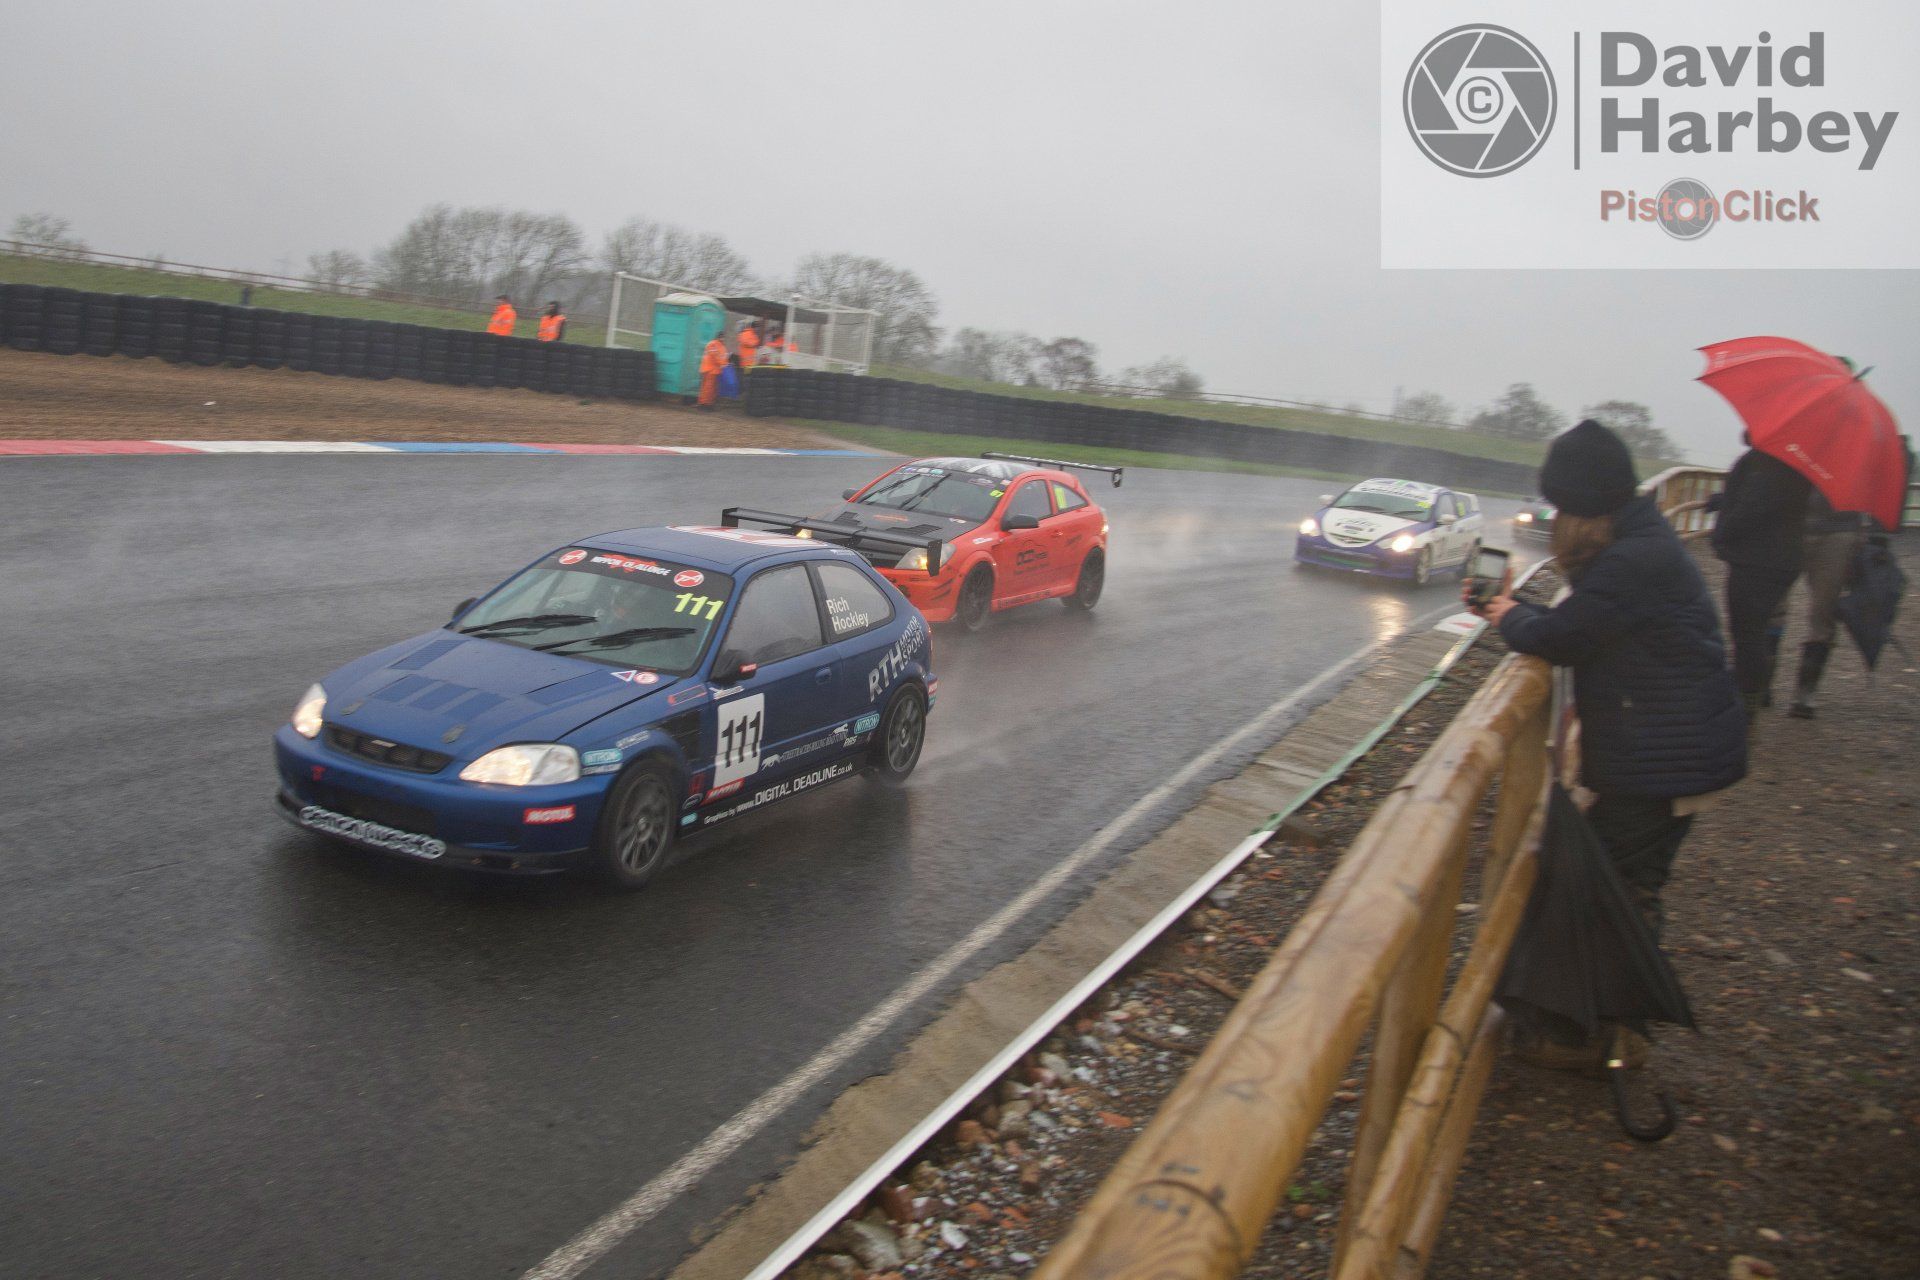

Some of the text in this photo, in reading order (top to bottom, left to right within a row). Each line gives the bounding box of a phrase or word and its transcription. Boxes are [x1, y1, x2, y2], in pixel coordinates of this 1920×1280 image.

[674, 592, 724, 621] 111
[826, 596, 850, 615] Rich
[831, 611, 869, 632] Hockley
[900, 615, 920, 650] MOTOR
[868, 640, 905, 703] RTH
[721, 710, 761, 769] 111
